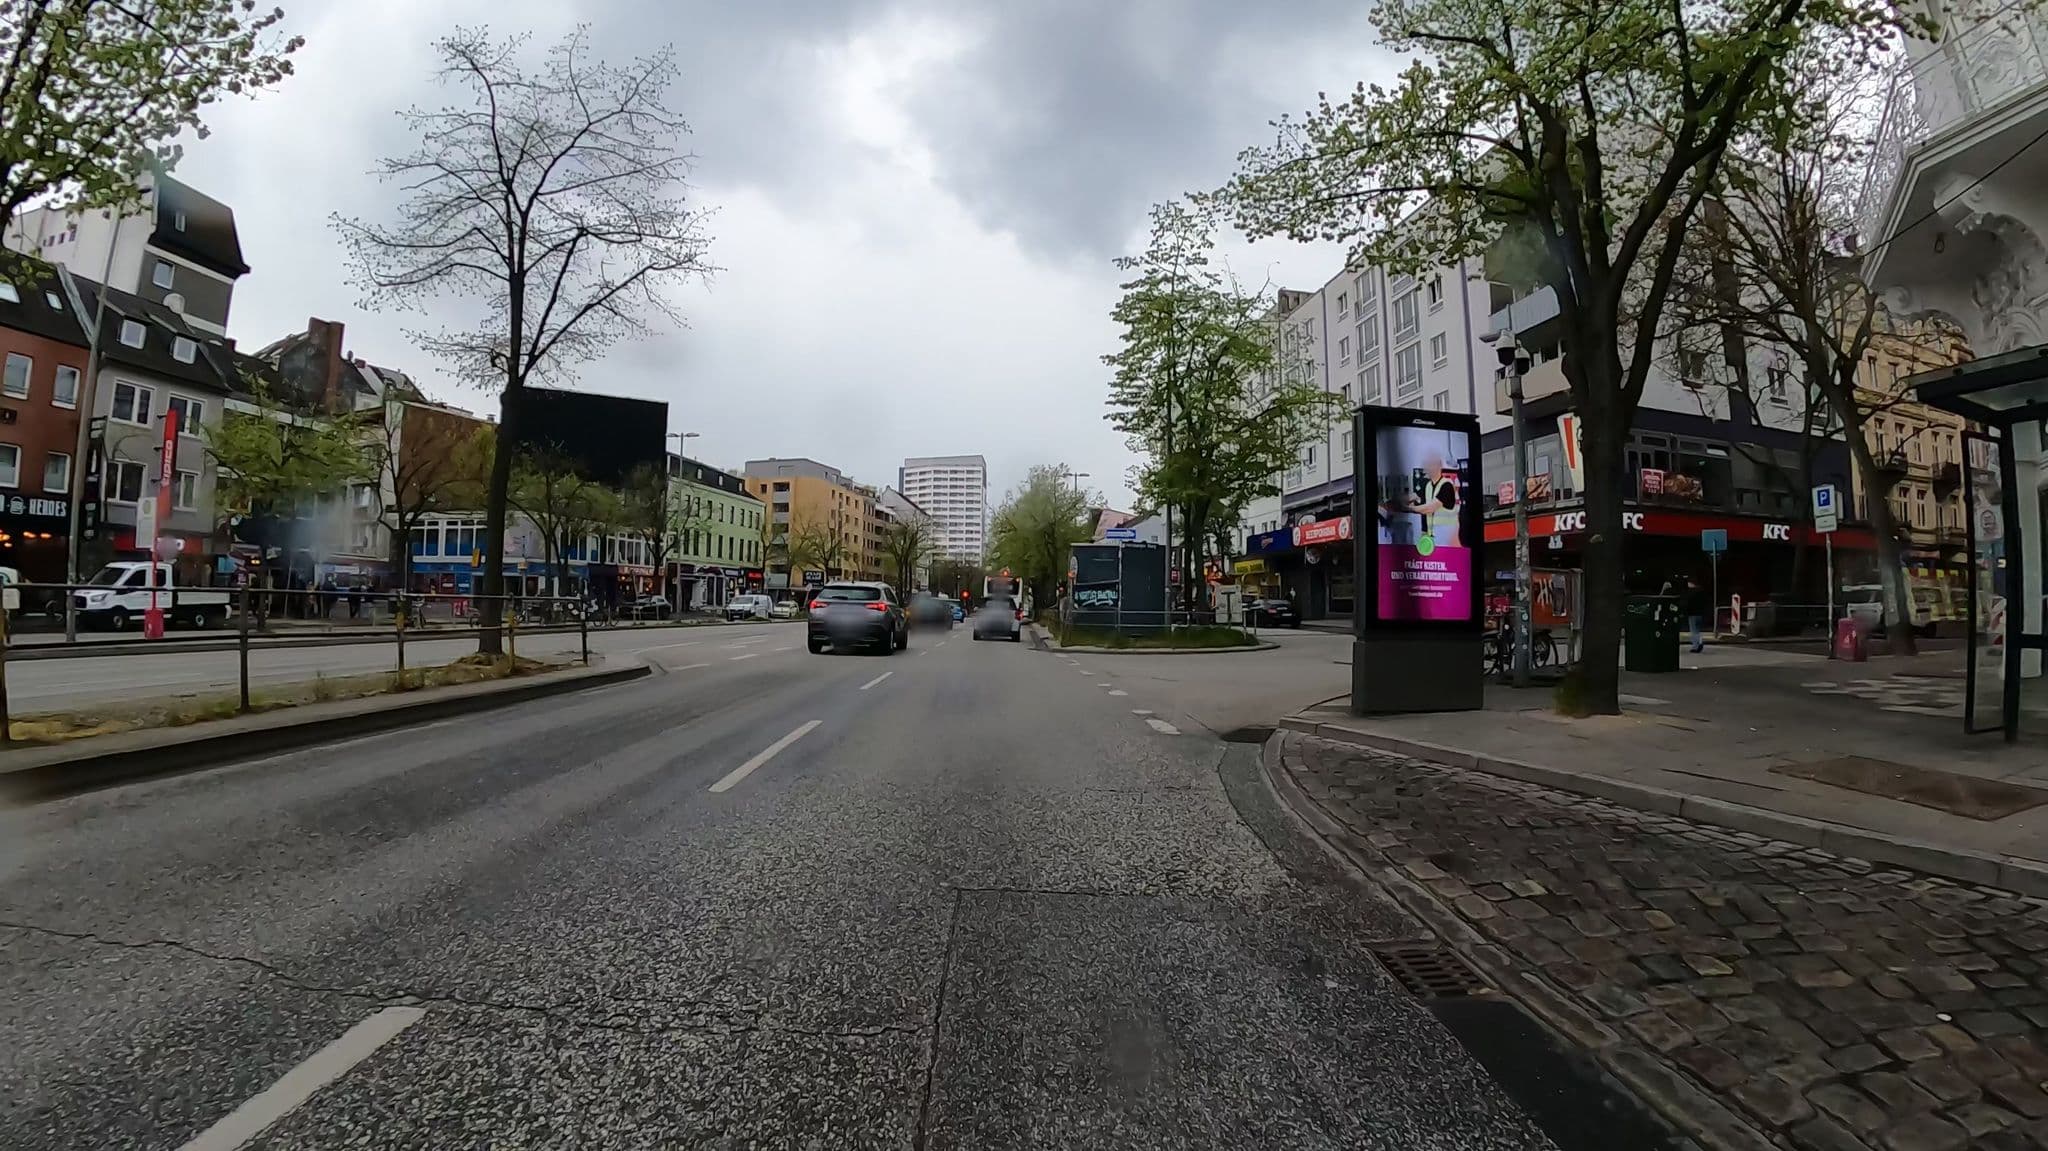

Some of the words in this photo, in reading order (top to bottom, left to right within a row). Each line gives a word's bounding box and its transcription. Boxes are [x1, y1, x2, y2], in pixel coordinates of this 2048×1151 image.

[1553, 511, 1586, 532] KFC
[1622, 512, 1644, 531] FC
[1762, 523, 1790, 541] KFC
